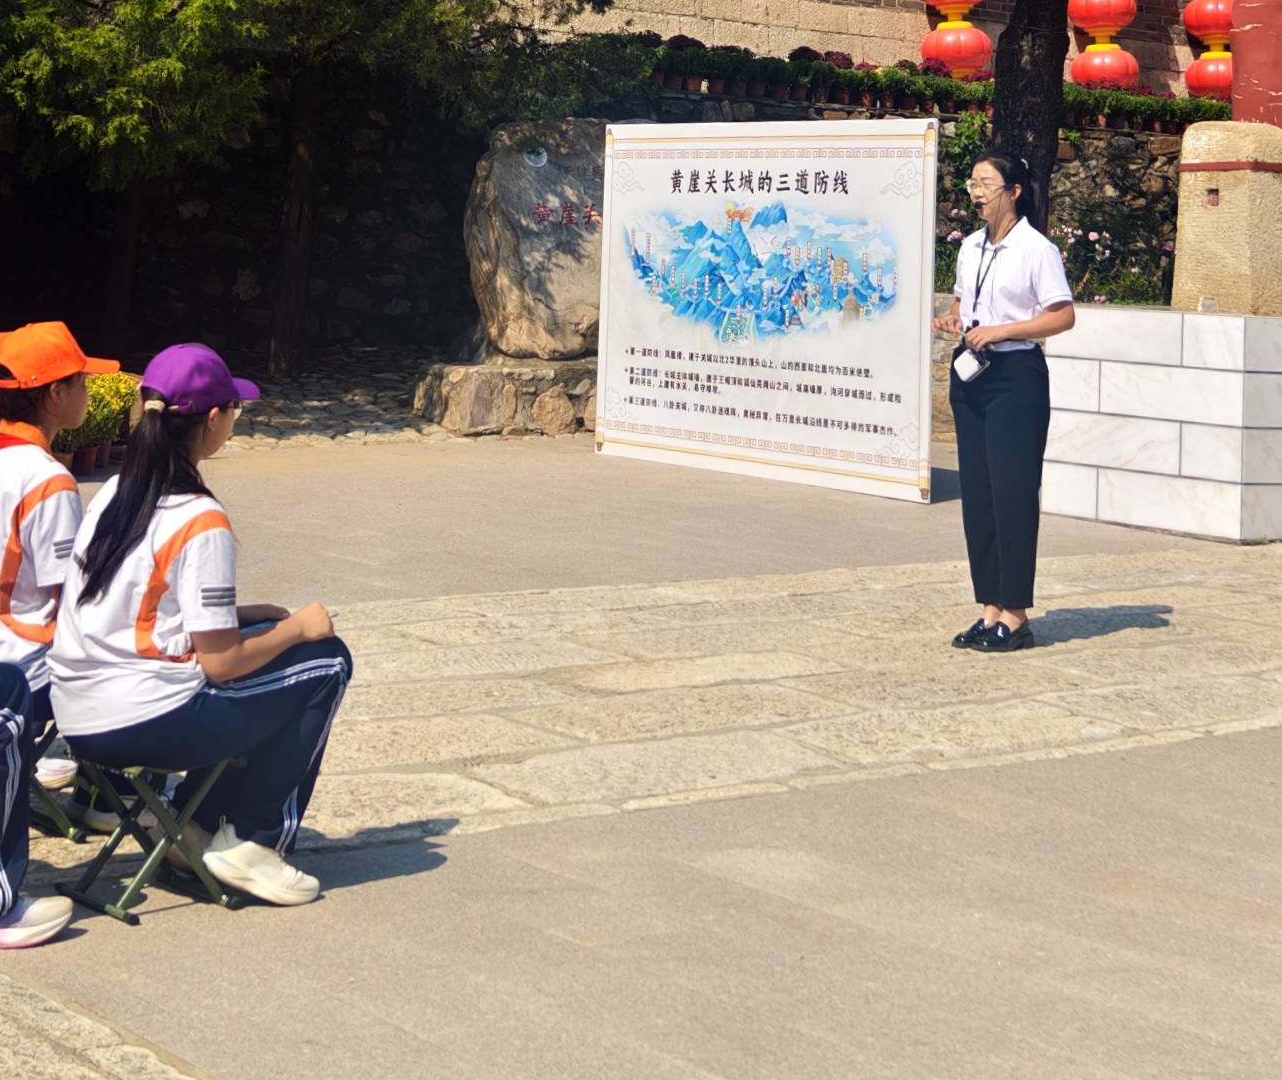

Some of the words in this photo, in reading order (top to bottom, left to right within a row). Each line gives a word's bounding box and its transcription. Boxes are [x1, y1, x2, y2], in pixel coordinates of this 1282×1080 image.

[670, 168, 849, 195] 黄崖关长城的三道防线
